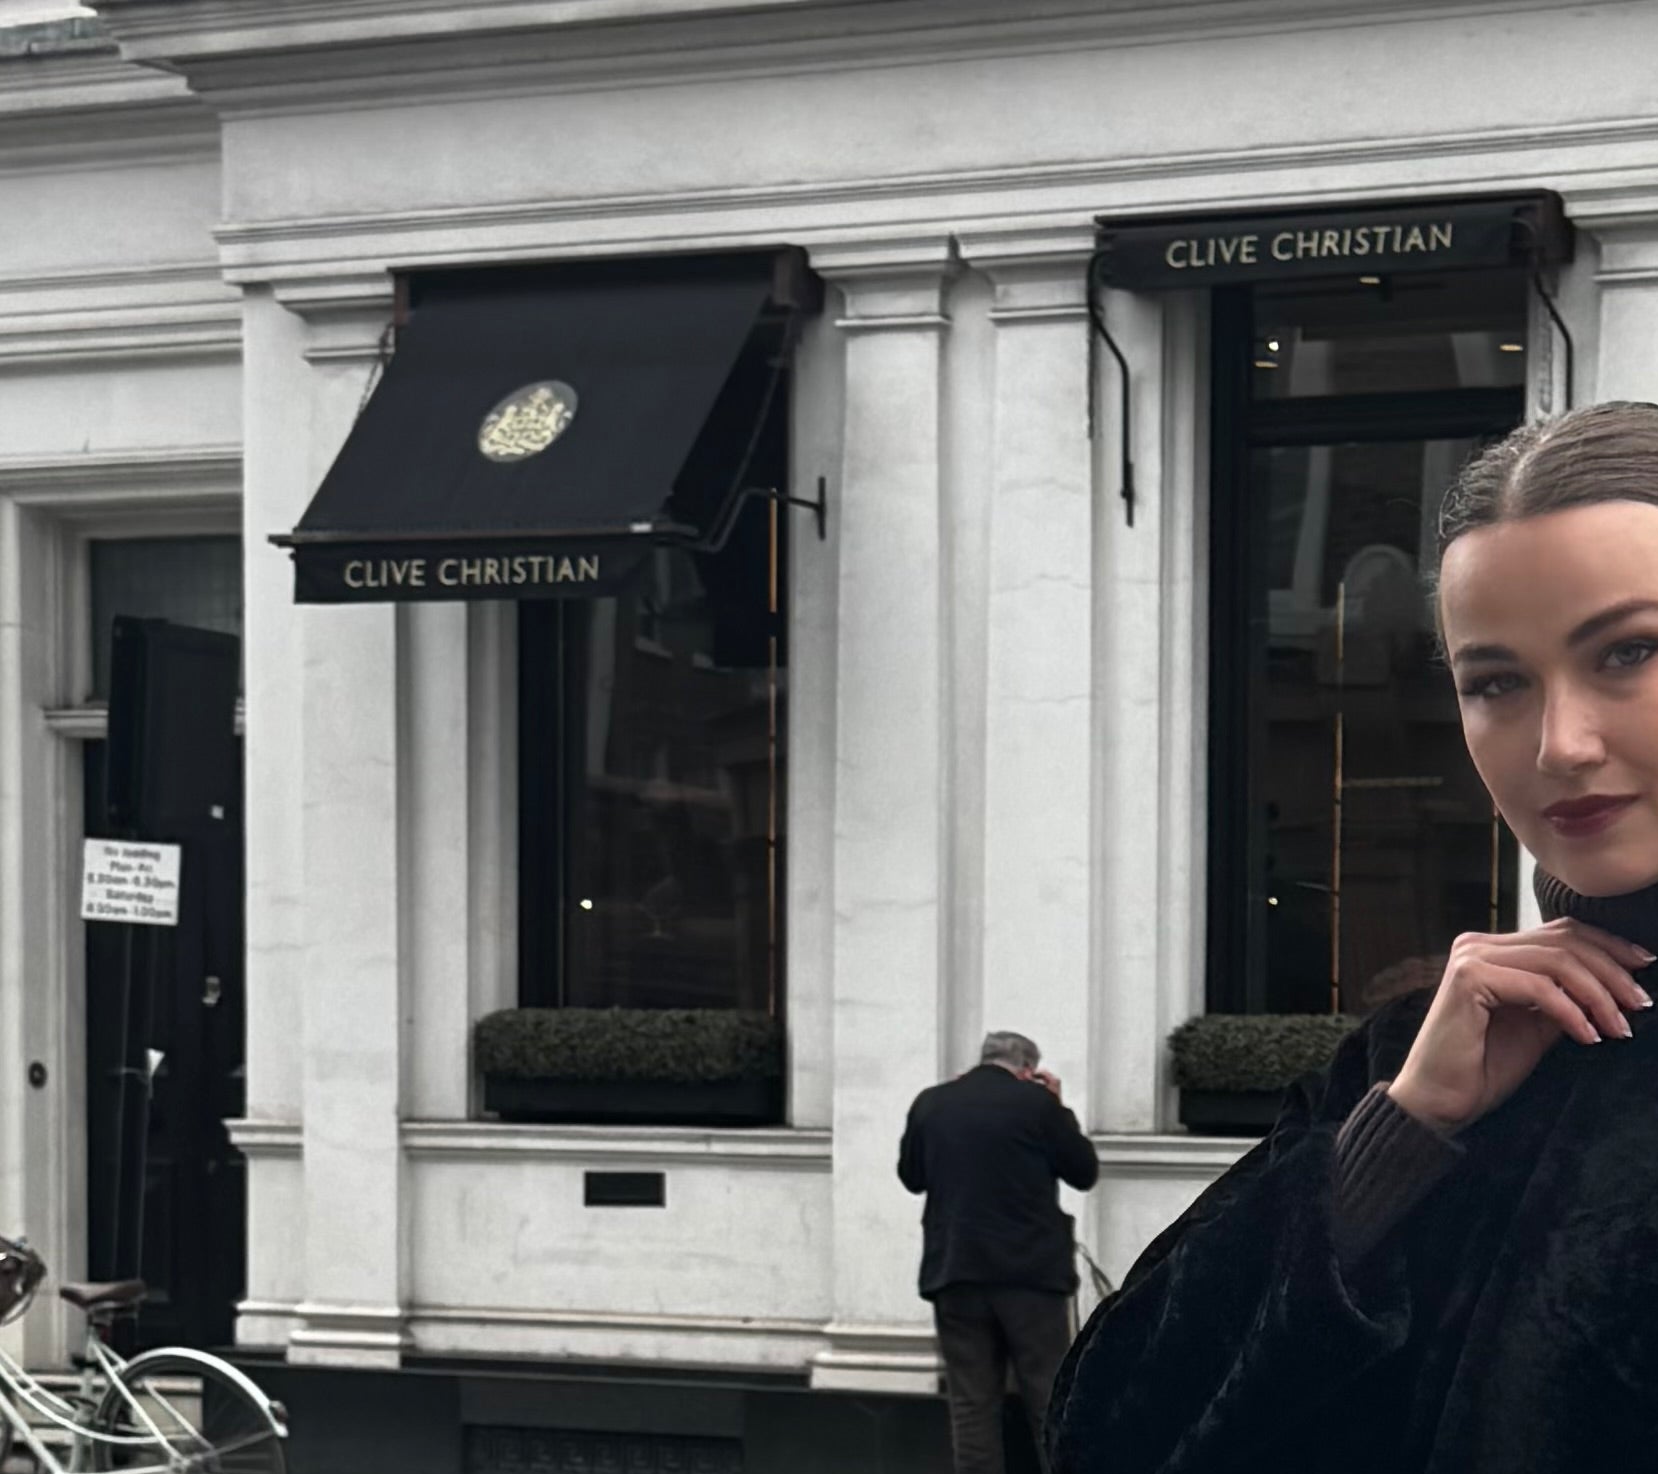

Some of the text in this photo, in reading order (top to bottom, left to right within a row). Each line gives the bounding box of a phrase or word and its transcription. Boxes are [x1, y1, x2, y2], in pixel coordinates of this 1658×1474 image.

[1165, 222, 1453, 269] CLIVE CHRISTIAN
[343, 554, 600, 588] CLIVE CHRISTIAN
